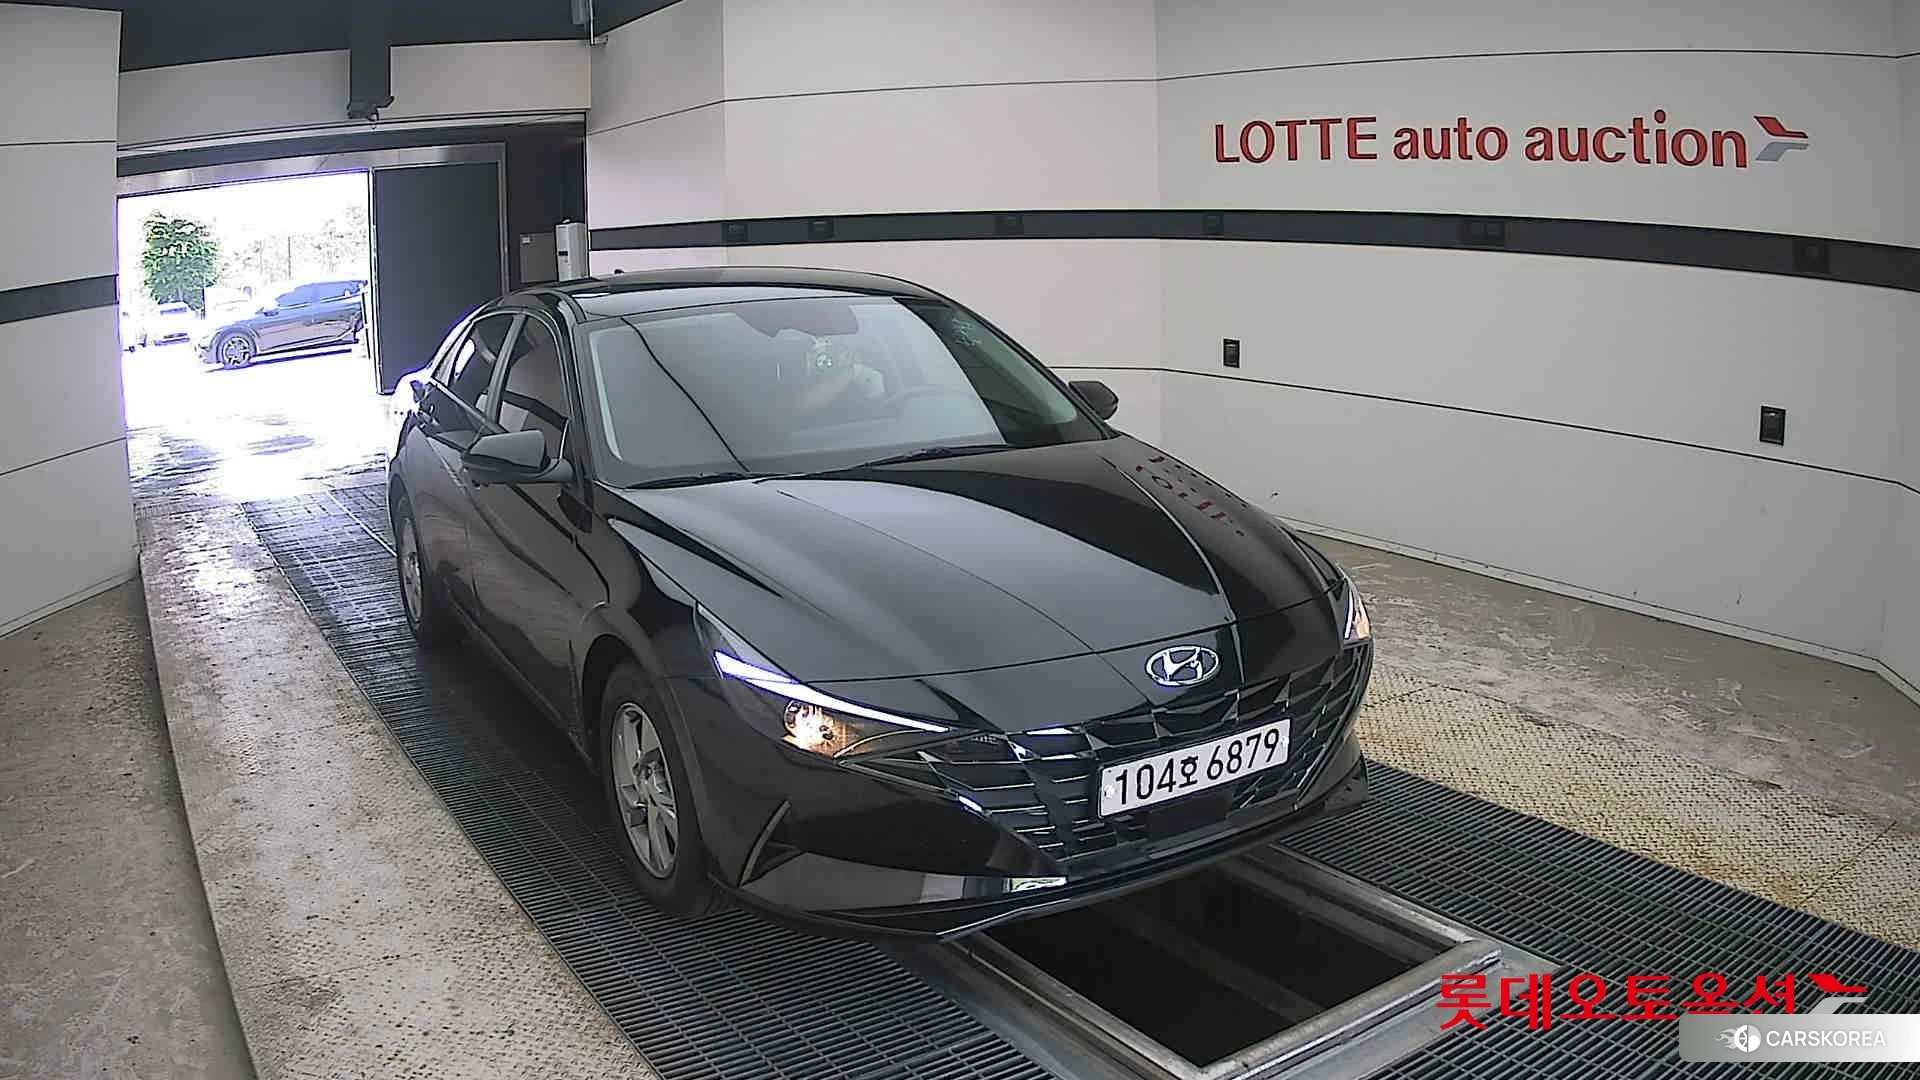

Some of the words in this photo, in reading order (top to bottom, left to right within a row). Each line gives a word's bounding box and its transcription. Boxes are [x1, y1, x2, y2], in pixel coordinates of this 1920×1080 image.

[1214, 116, 1378, 164] LOTTE
[1392, 116, 1509, 161] auto
[1524, 109, 1748, 169] auction
